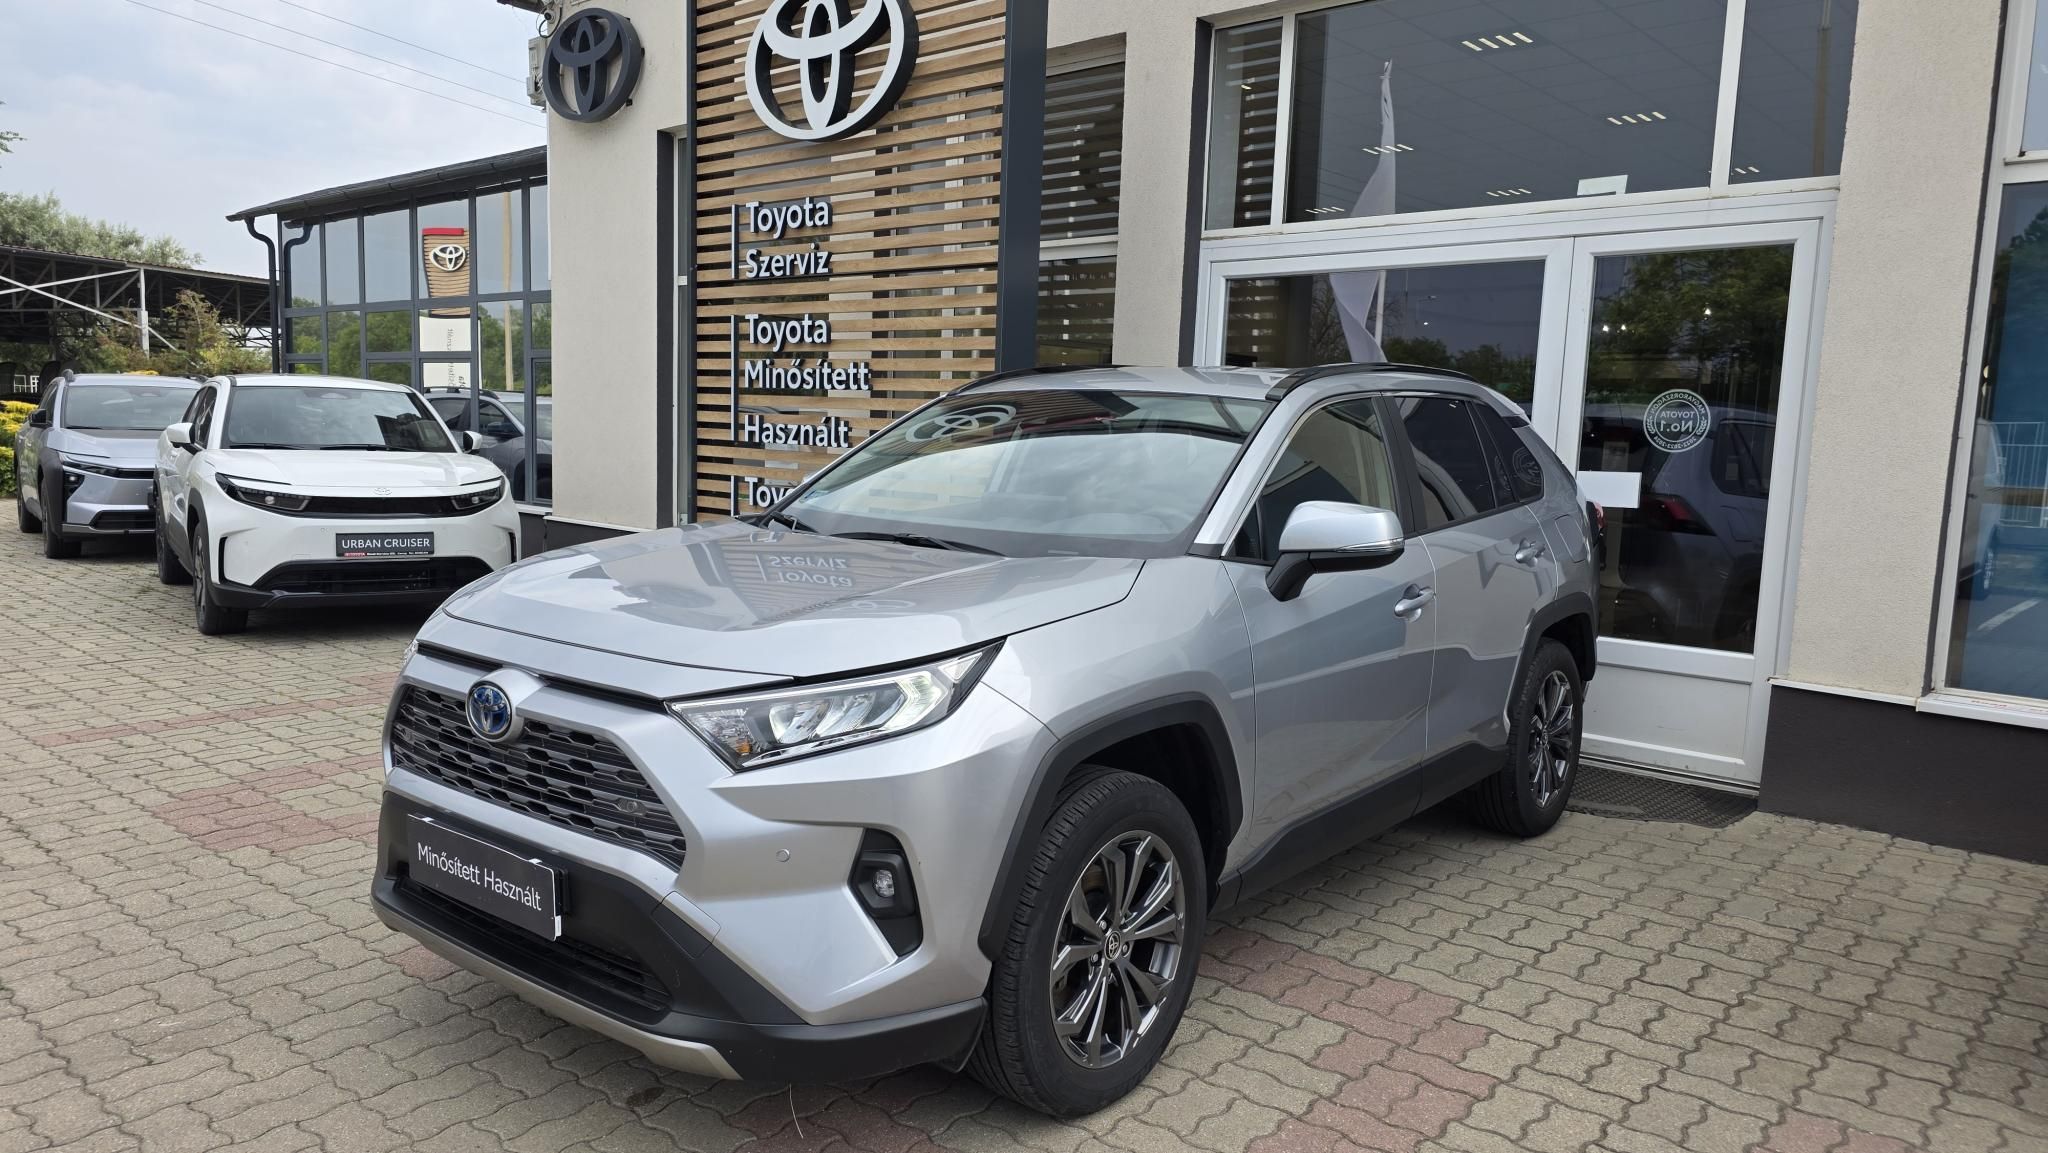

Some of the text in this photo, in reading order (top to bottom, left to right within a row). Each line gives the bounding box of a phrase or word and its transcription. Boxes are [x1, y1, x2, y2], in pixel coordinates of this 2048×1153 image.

[745, 197, 831, 238] Toyota
[745, 242, 831, 279] Szerviz
[745, 313, 829, 352] Toyota
[744, 358, 871, 390] Minősített
[744, 414, 849, 448] Használt
[745, 476, 795, 507] Toy
[342, 537, 430, 549] URBAN CRUISER
[417, 842, 542, 912] Minősített Használt
